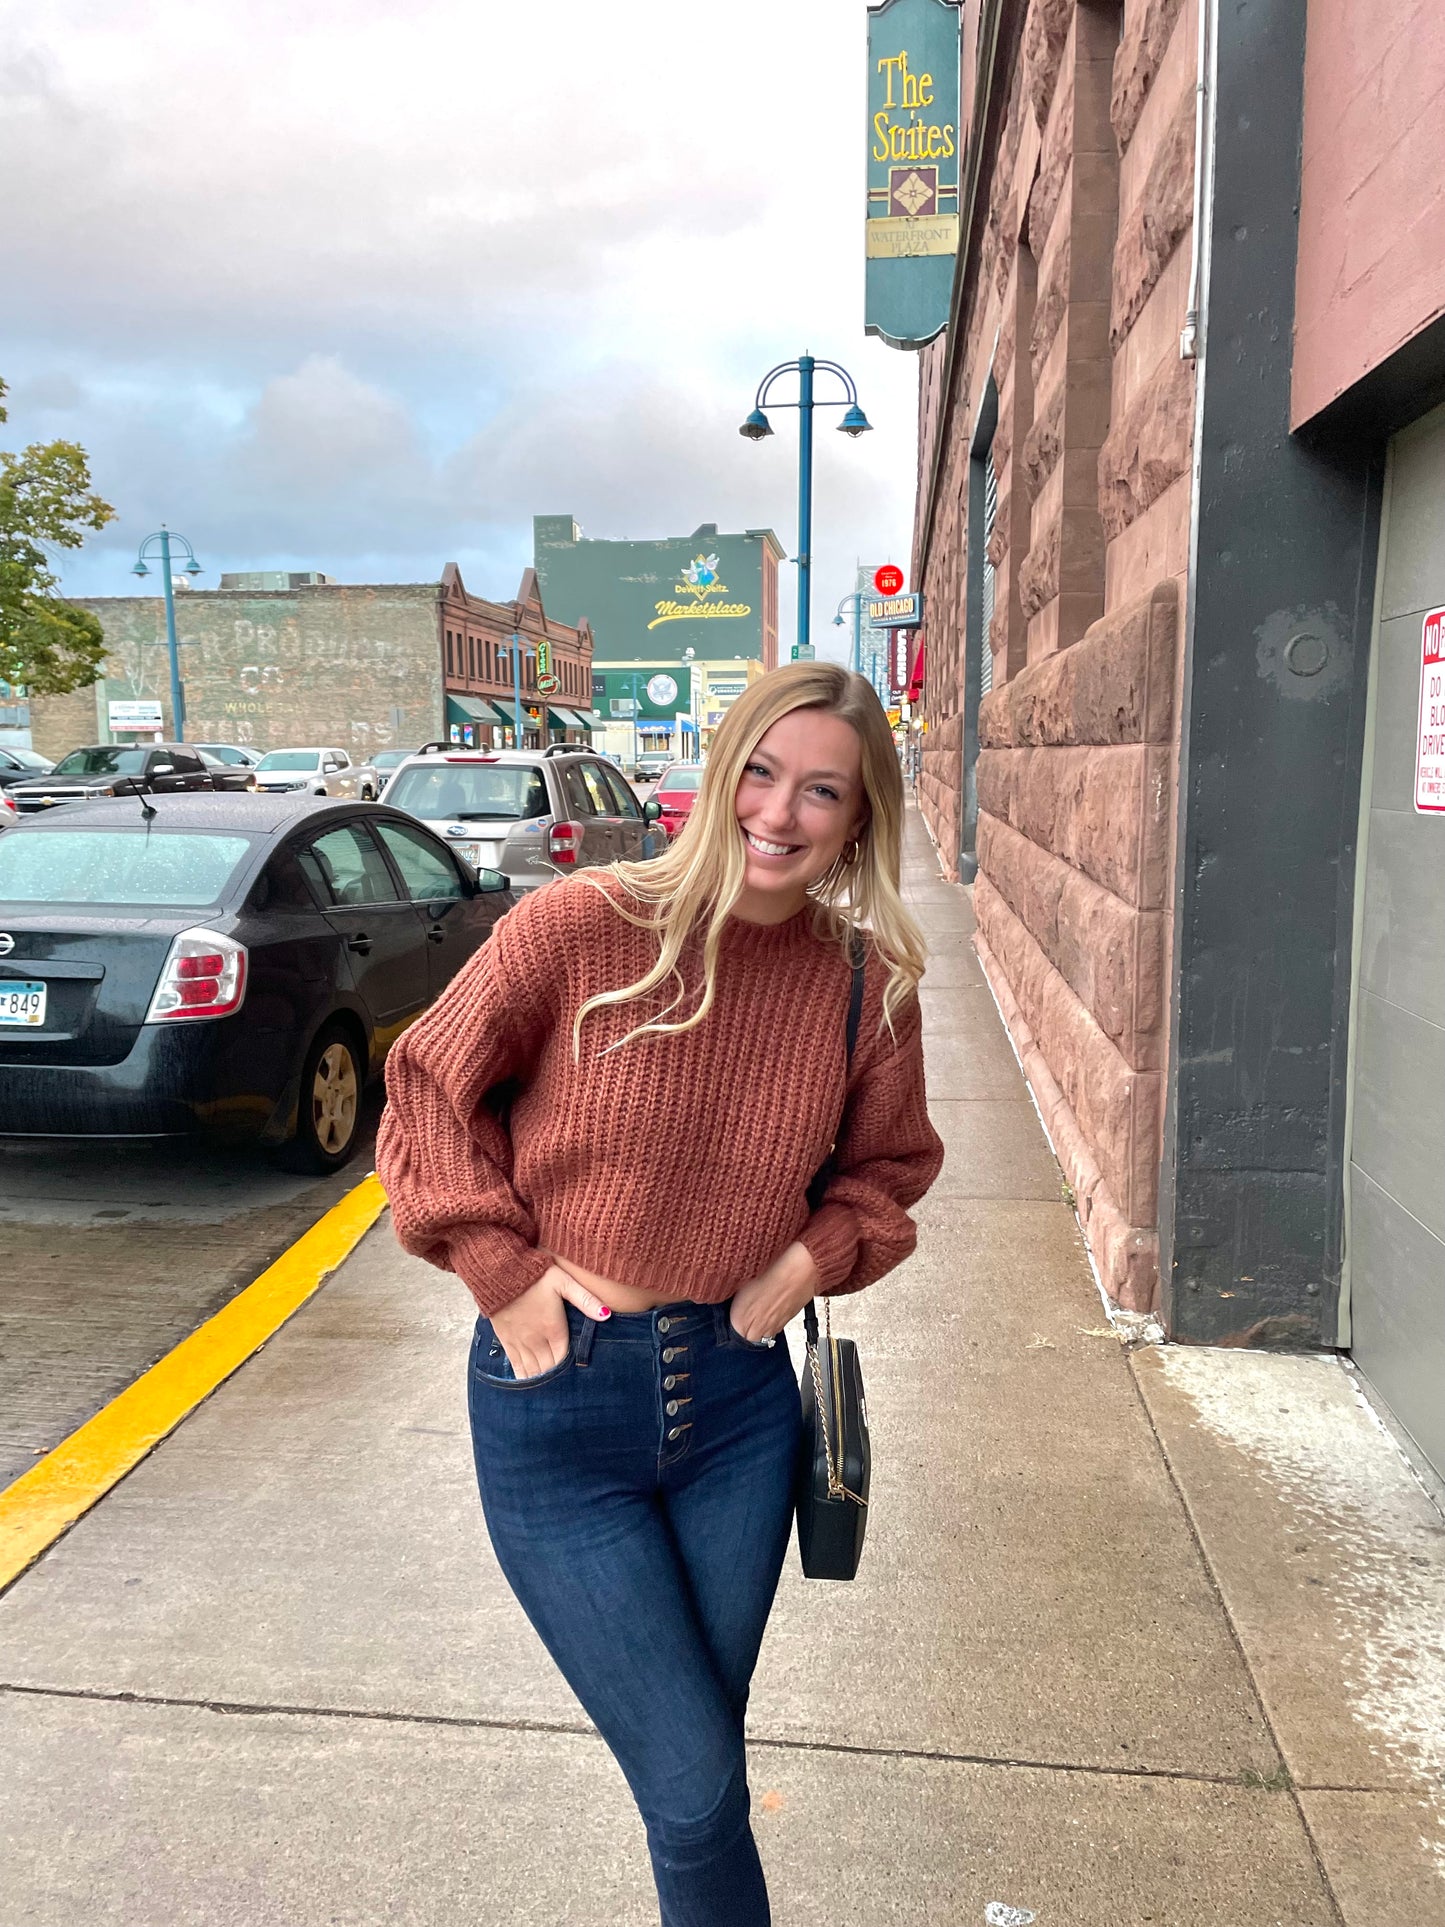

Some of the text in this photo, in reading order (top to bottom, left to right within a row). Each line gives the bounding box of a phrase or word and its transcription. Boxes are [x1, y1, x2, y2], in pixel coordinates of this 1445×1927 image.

[878, 50, 934, 109] The
[873, 110, 955, 162] Suites
[871, 228, 952, 242] WATERFRONT
[891, 241, 929, 254] PLAZA
[881, 578, 897, 588] 1976
[653, 600, 751, 620] Marketplace
[870, 597, 914, 618] OLD CHICAGO
[1425, 623, 1439, 657] NO
[1430, 675, 1441, 699] DO
[10, 993, 40, 1014] 849
